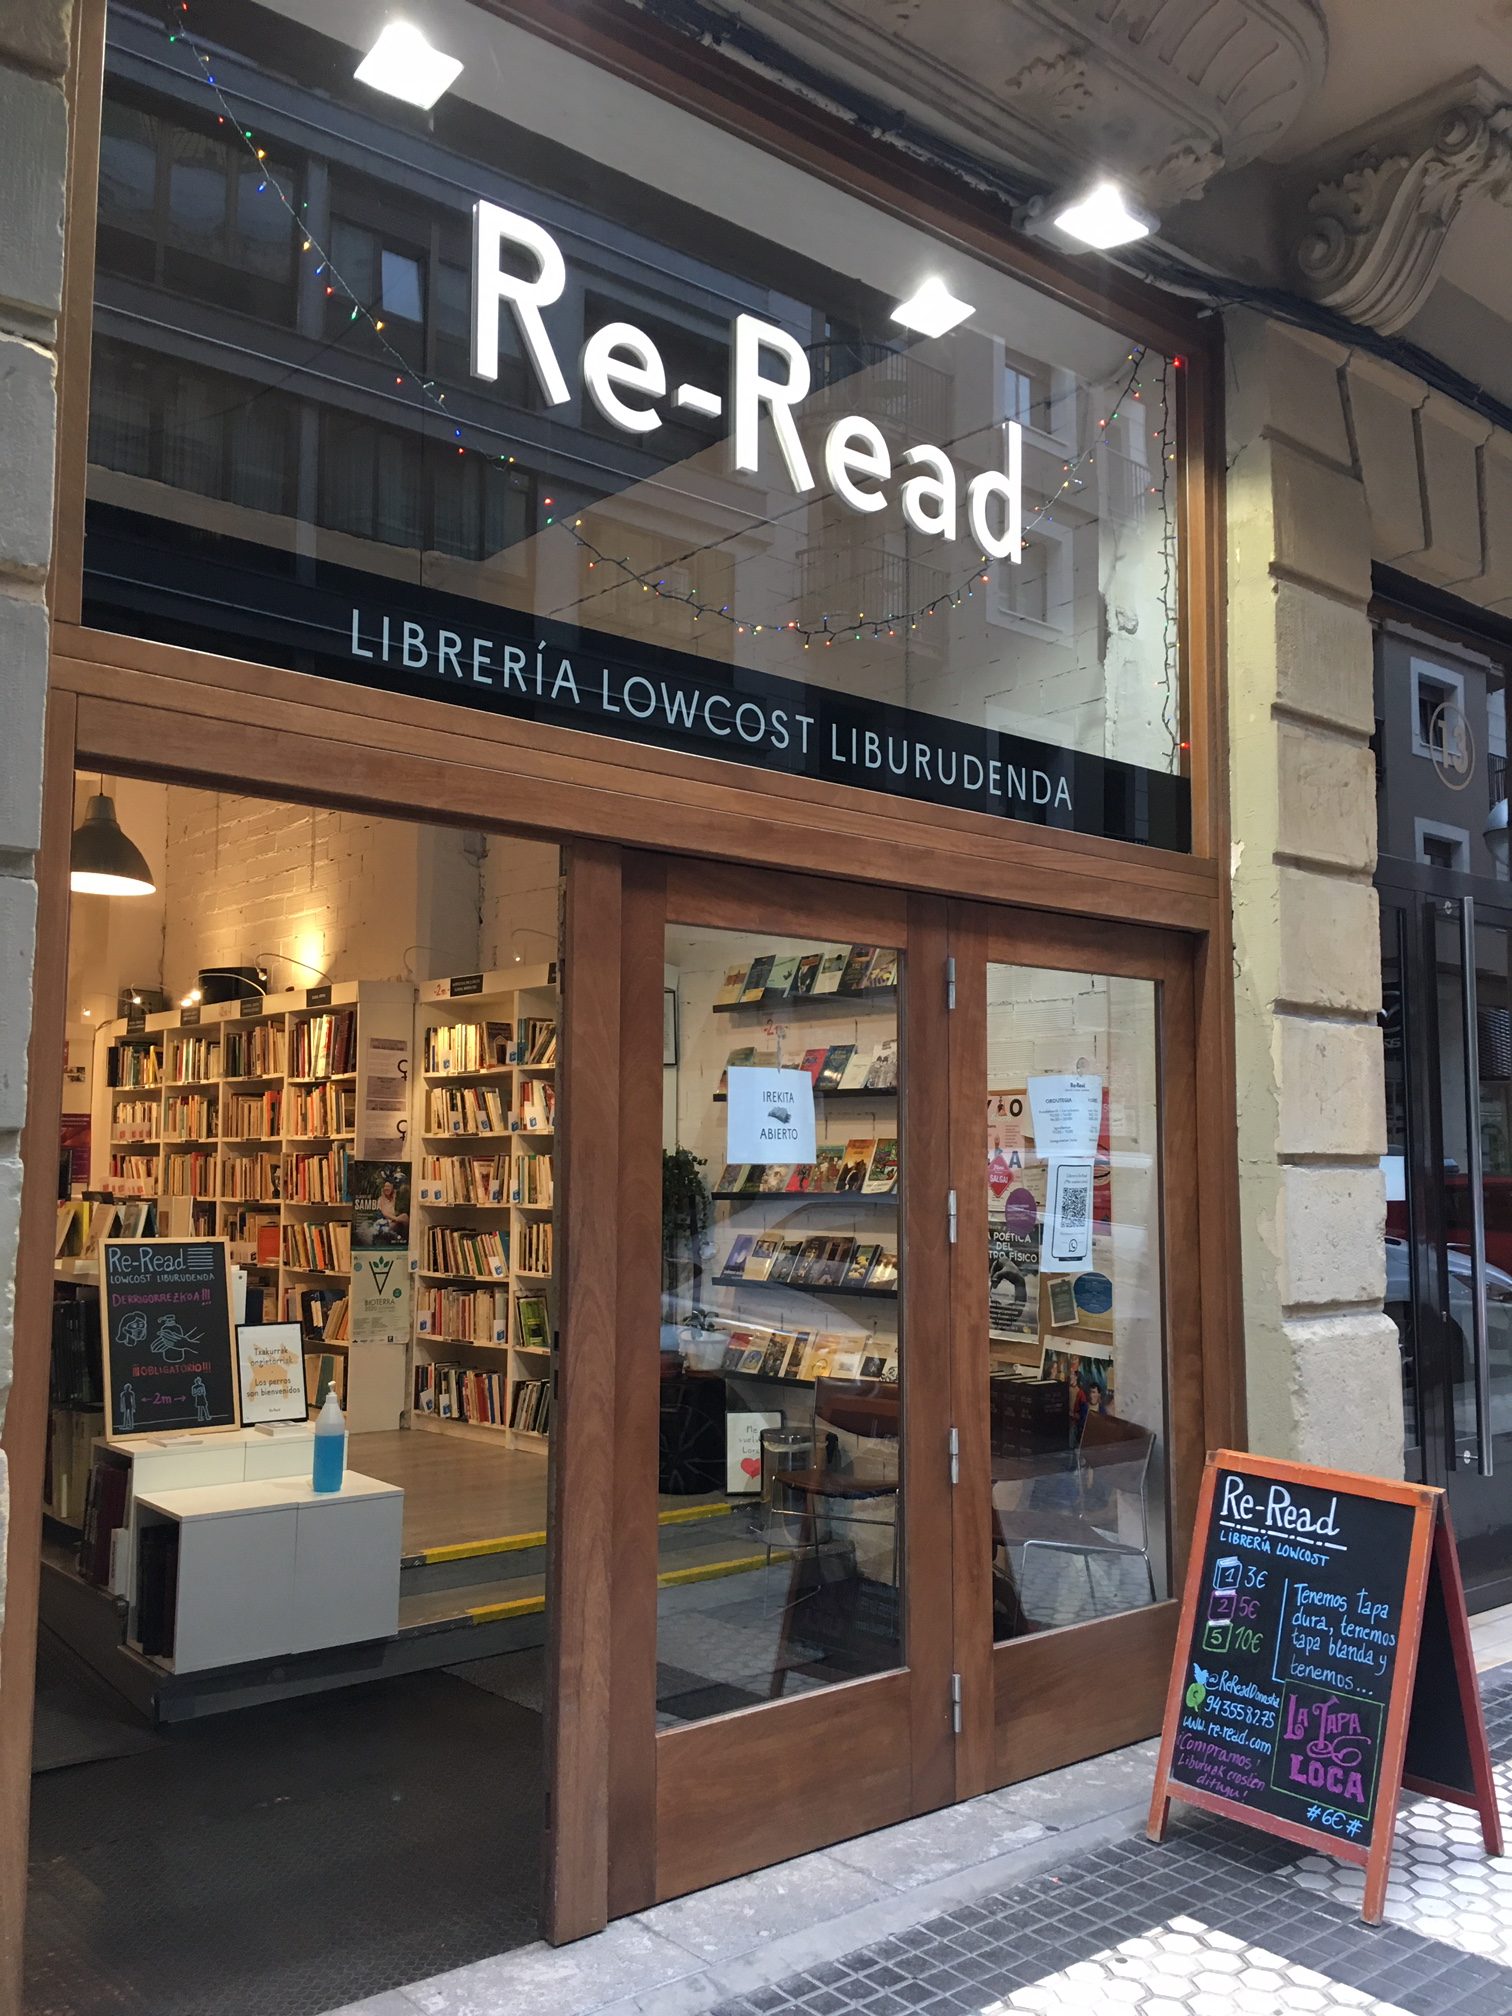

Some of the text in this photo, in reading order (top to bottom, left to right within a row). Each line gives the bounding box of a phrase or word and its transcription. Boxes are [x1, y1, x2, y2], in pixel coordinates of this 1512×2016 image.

[470, 199, 1022, 565] Re-Read
[351, 608, 1073, 811] LIBRERÍA LOWCOST LIBURUDENDA
[762, 1091, 794, 1104] IREKITA
[760, 1128, 798, 1140] ABIERTO
[996, 1241, 1013, 1251] DEL
[108, 1247, 186, 1273] Re-Read
[110, 1272, 215, 1285] LOWCOST LIBURUDENDA
[246, 1390, 259, 1398] son
[254, 1378, 292, 1388] Los perros
[152, 1392, 172, 1405] 2m
[1220, 1475, 1340, 1536] Re-Read
[1276, 1542, 1330, 1567] LOWCOST
[1244, 1566, 1269, 1588] 3€
[1239, 1596, 1261, 1619] 5€
[1294, 1583, 1348, 1612] Tenemos
[1292, 1606, 1396, 1646] dura, tenemos
[1235, 1626, 1264, 1653] 10€
[1291, 1627, 1388, 1676] tapa blanda y
[1290, 1653, 1373, 1695] tenemos...
[1288, 1753, 1365, 1803] LOCA
